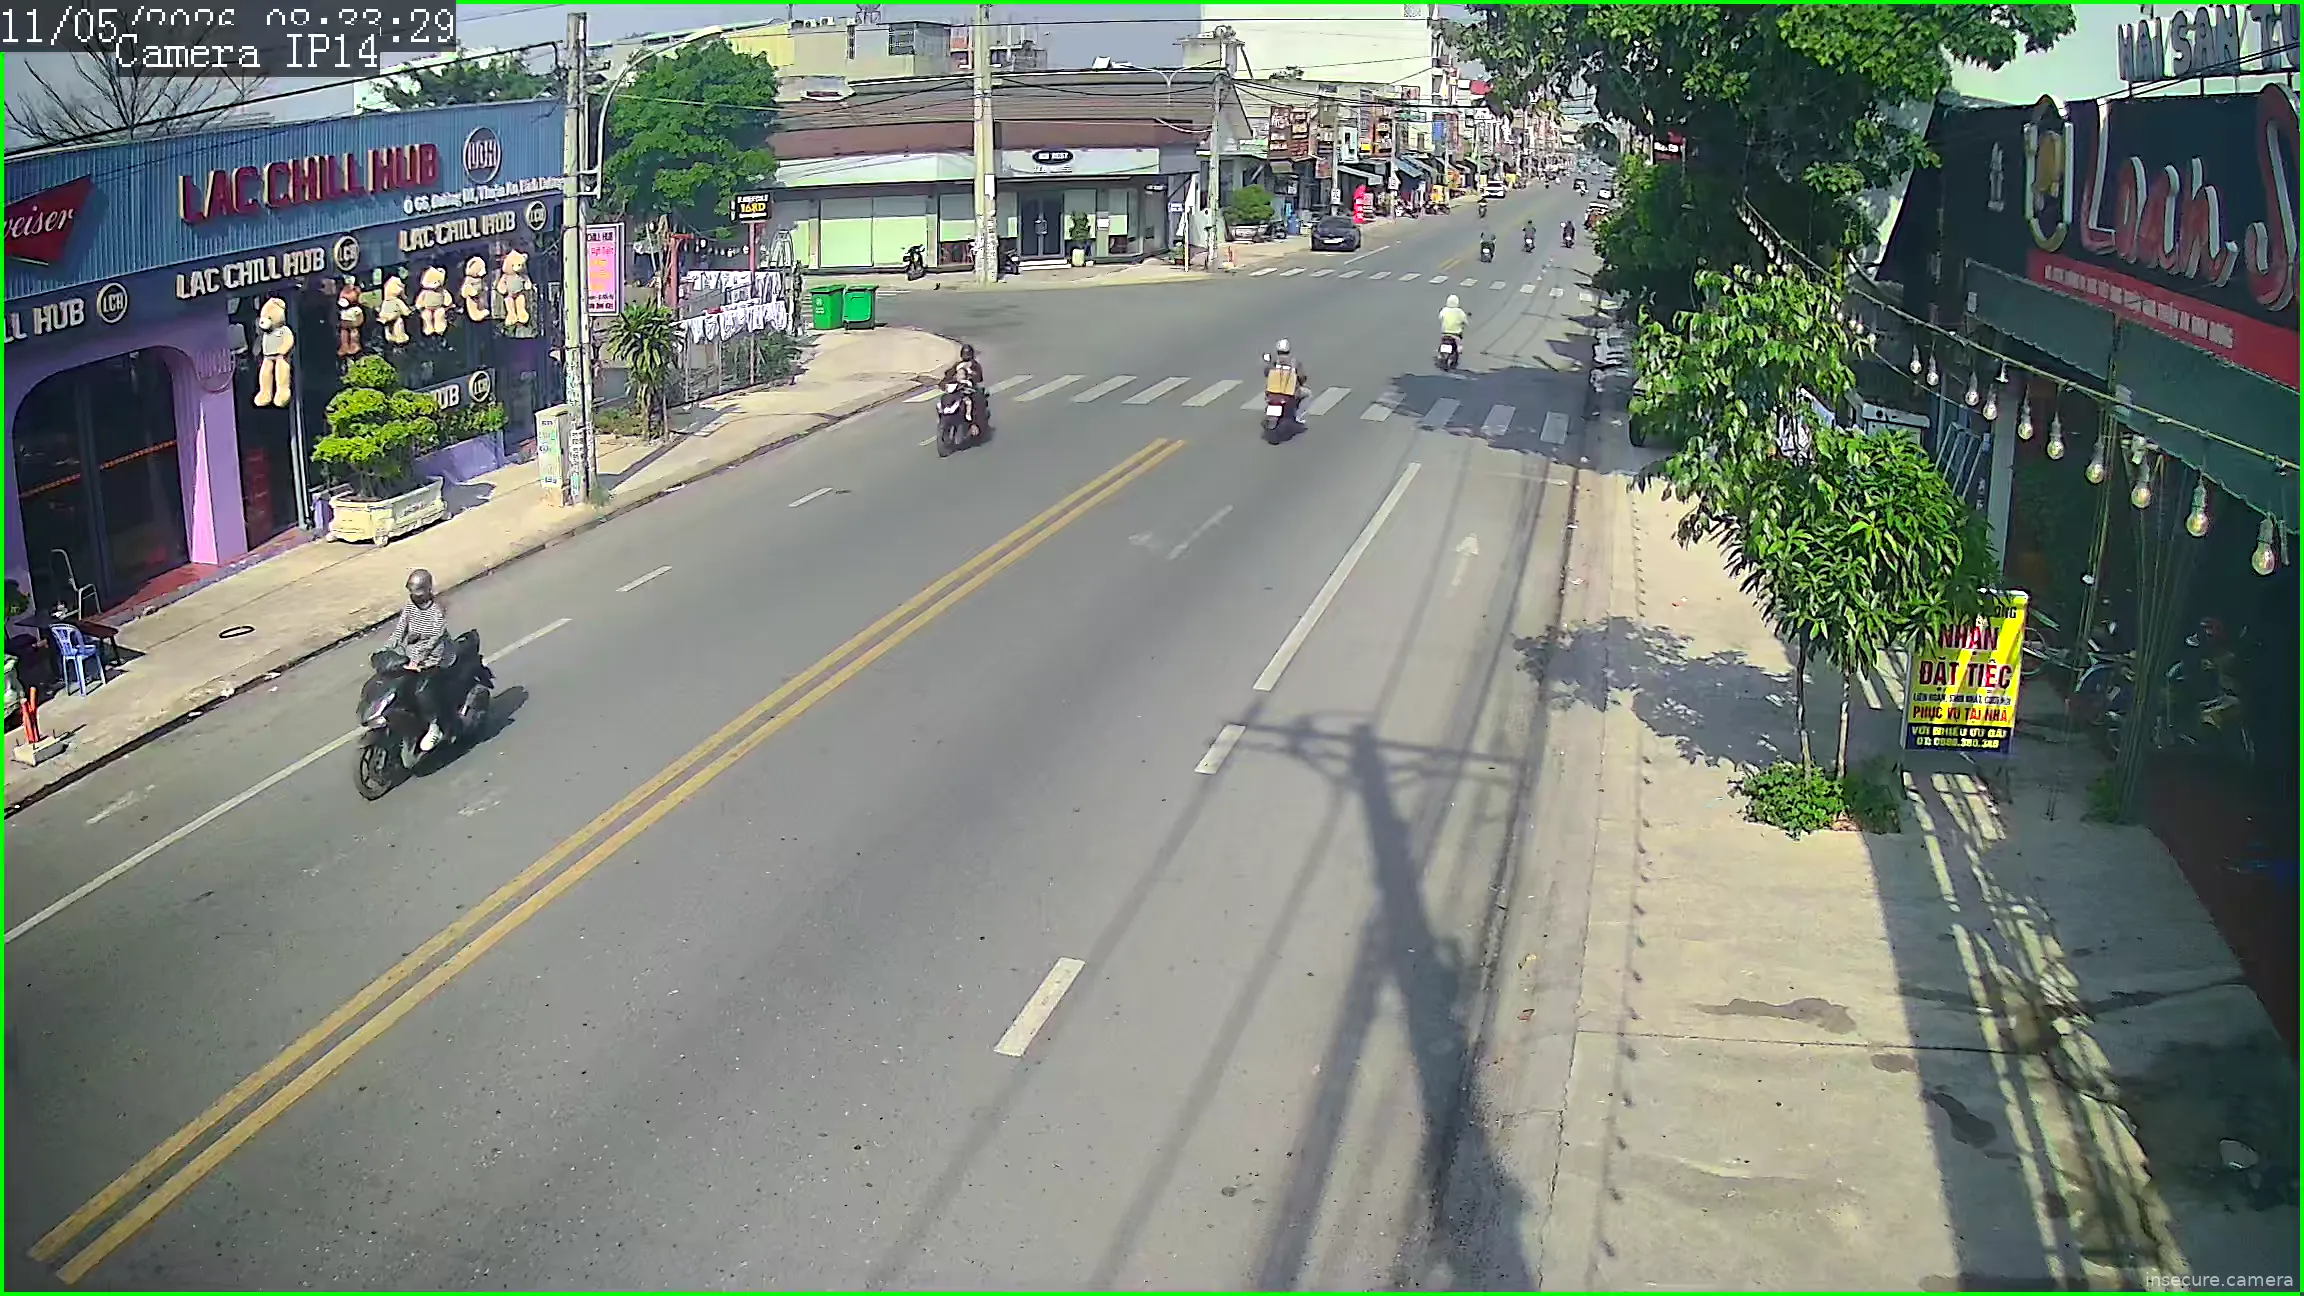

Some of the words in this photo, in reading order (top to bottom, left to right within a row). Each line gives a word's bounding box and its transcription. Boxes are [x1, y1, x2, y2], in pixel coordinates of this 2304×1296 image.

[178, 166, 262, 224] LAC
[263, 152, 366, 208] CHILL
[367, 143, 439, 193] HUB
[399, 225, 435, 252] LAC
[435, 216, 481, 245] CHILL
[481, 211, 517, 236] HUB
[176, 268, 221, 299] LAC
[223, 255, 283, 289] CHILL
[283, 247, 326, 276] HUB
[32, 298, 85, 335] HUB
[1919, 656, 1959, 692] ĐẶT
[1967, 659, 2012, 694] TIỆC
[1965, 707, 1982, 724] TẠI
[1984, 707, 2008, 723] NHÀ
